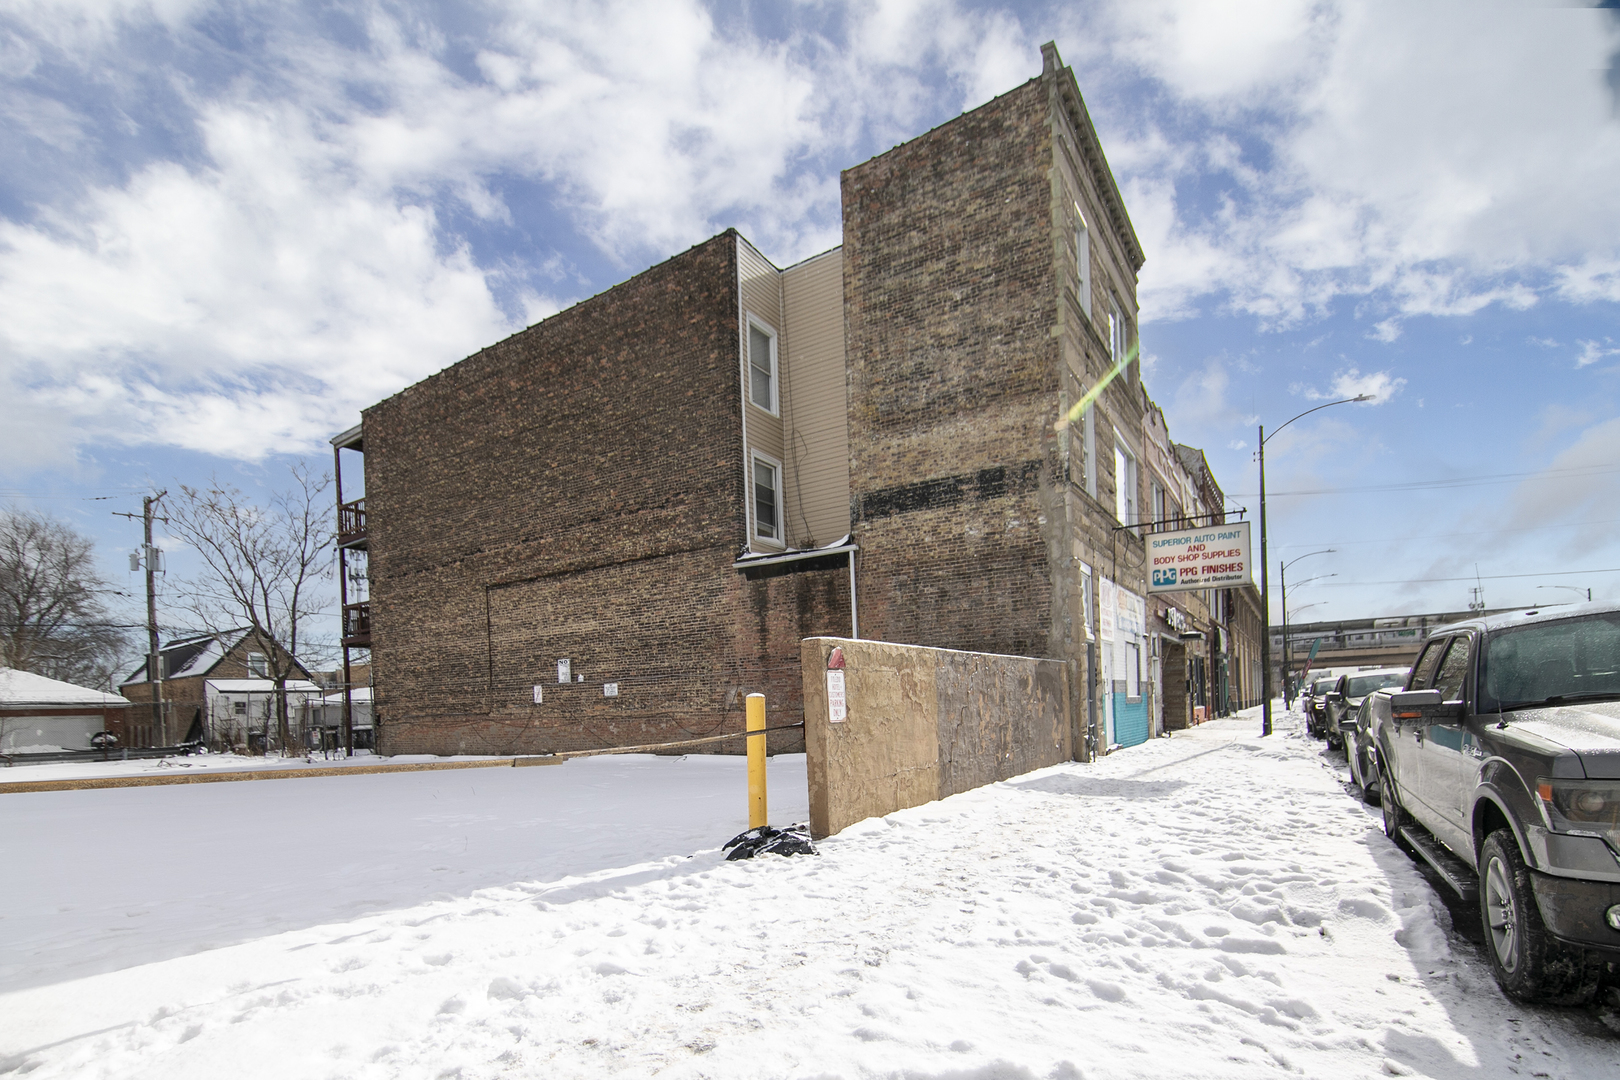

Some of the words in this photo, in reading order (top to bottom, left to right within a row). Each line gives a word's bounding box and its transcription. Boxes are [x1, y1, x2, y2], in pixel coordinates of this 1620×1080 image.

[1152, 536, 1192, 548] SUPERIOR
[1194, 534, 1216, 544] AUTO
[1218, 530, 1242, 540] PAINT
[1187, 544, 1206, 552] AND
[1154, 556, 1176, 565] BODY
[1177, 554, 1200, 562] SHOP
[1202, 548, 1241, 560] SUPPLIES
[1154, 568, 1176, 583] PPG
[1180, 566, 1198, 577] PPG
[1202, 562, 1244, 574] FINISHES
[1180, 576, 1210, 584] Authored
[1212, 574, 1242, 582] Distributor
